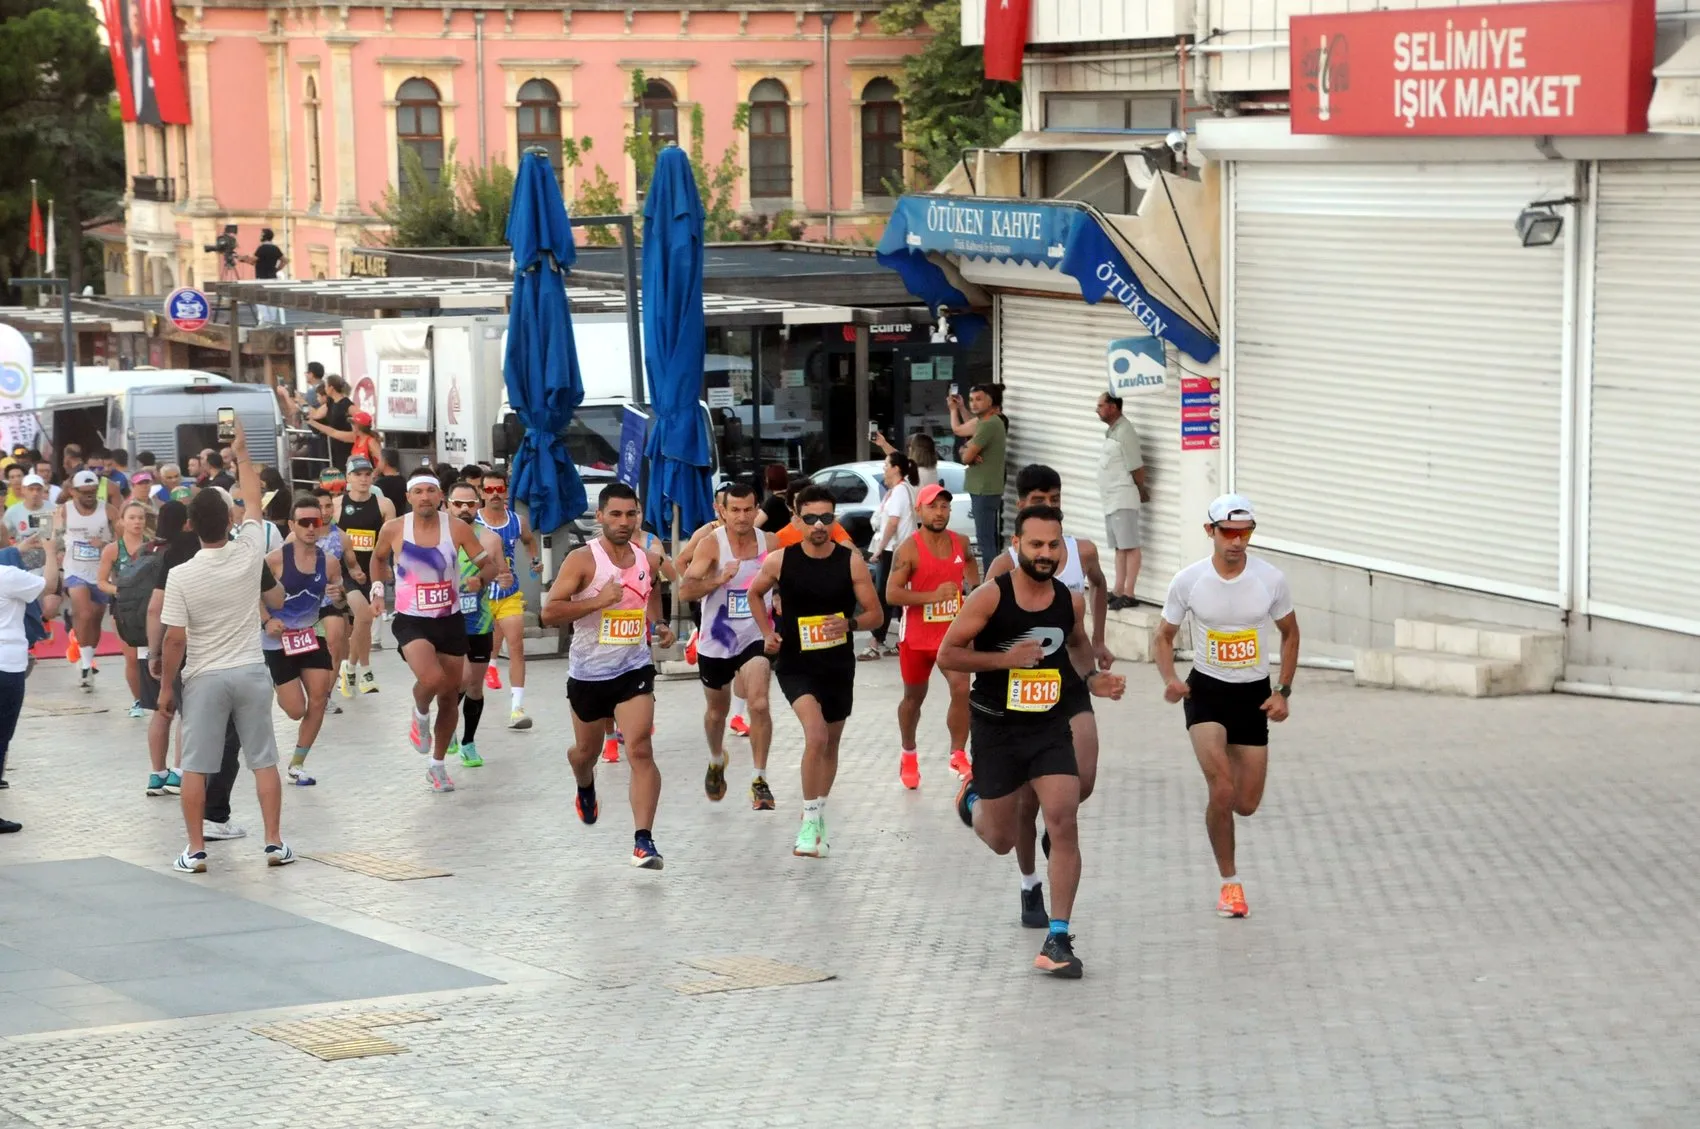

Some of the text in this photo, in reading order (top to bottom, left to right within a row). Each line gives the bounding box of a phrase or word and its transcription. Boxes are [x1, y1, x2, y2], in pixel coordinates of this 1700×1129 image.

[1393, 18, 1527, 72] SELİMİYE
[1394, 75, 1582, 128] IŞIK MARKET
[927, 200, 1041, 240] ÖTÜKEN KAHVE
[1096, 261, 1168, 337] ÖTÜKEN
[1118, 373, 1164, 389] LAVAZZA
[444, 431, 467, 452] Edirne
[354, 535, 373, 546] 1151
[430, 588, 449, 603] 515
[934, 599, 958, 615] 1105
[612, 619, 641, 636] 1003
[293, 632, 312, 648] 514
[1220, 640, 1256, 660] 1336
[1023, 681, 1059, 701] 1318
